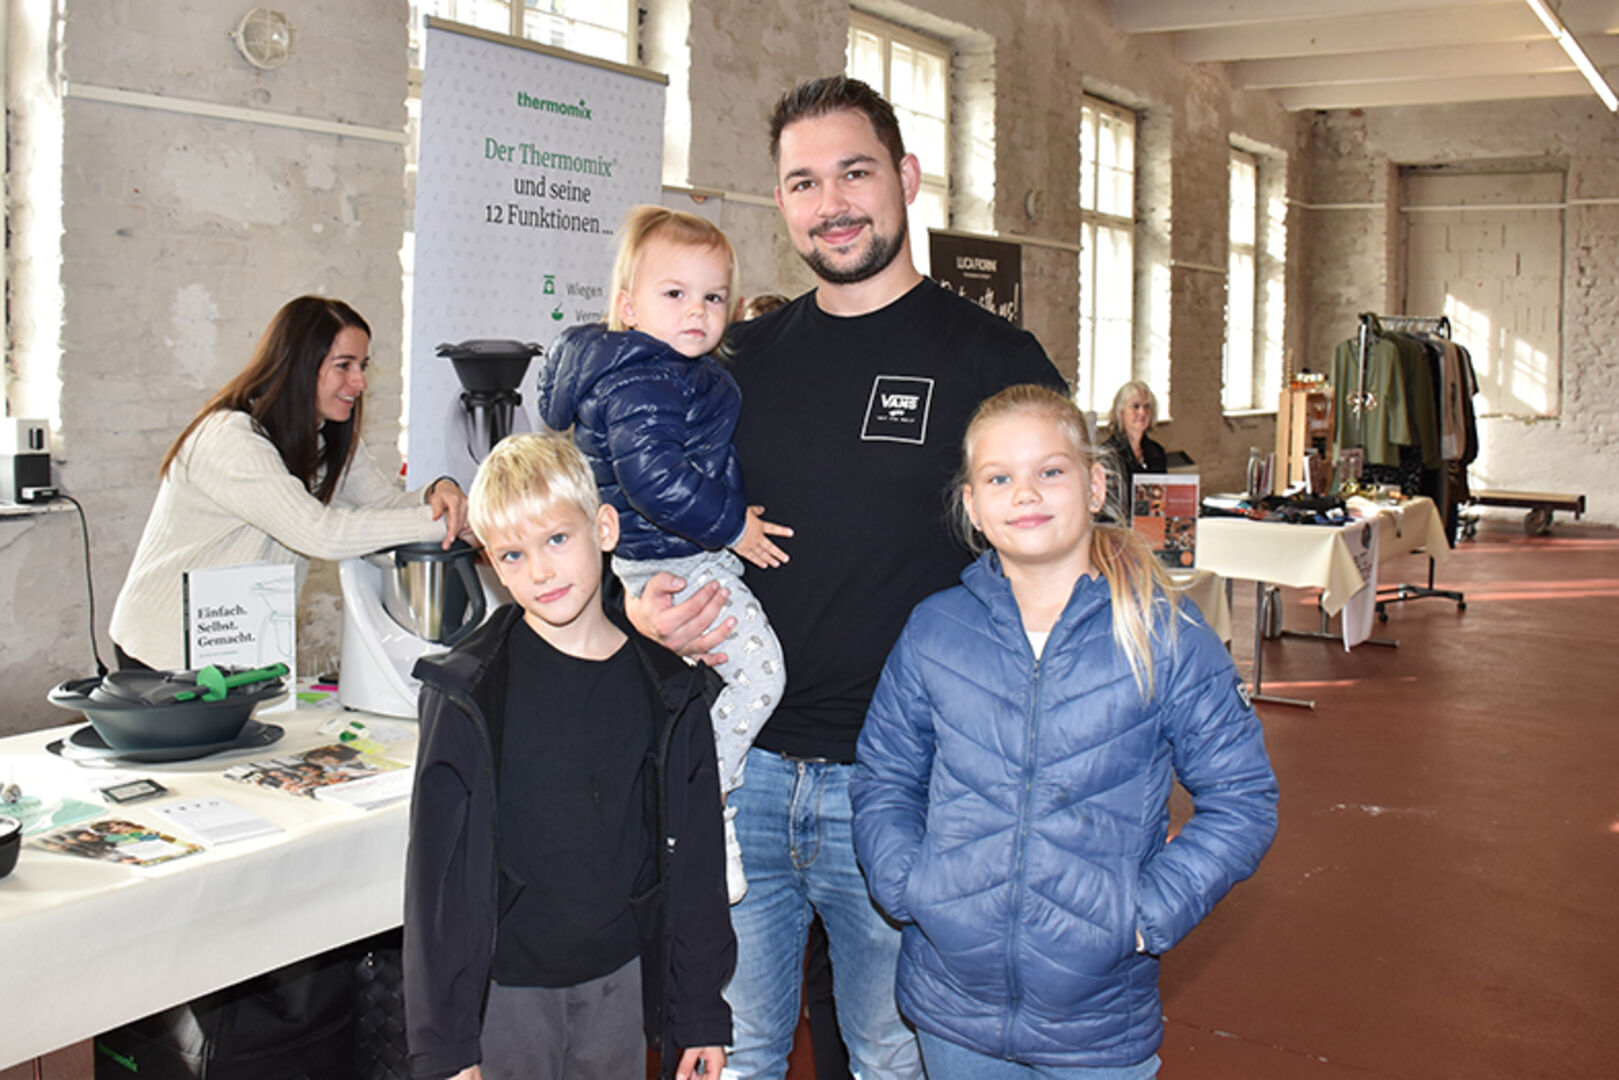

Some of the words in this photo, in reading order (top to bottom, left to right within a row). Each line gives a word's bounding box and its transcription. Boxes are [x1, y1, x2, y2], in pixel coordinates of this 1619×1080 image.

[517, 90, 592, 120] thermomix
[485, 137, 516, 162] Der
[514, 175, 546, 198] und
[549, 180, 592, 204] seine
[486, 204, 504, 224] 12
[566, 281, 604, 301] Wiegen
[881, 393, 920, 411] VANS
[198, 604, 247, 619] Einfach.
[198, 621, 238, 633] Selbst.
[198, 632, 255, 647] Gemacht.
